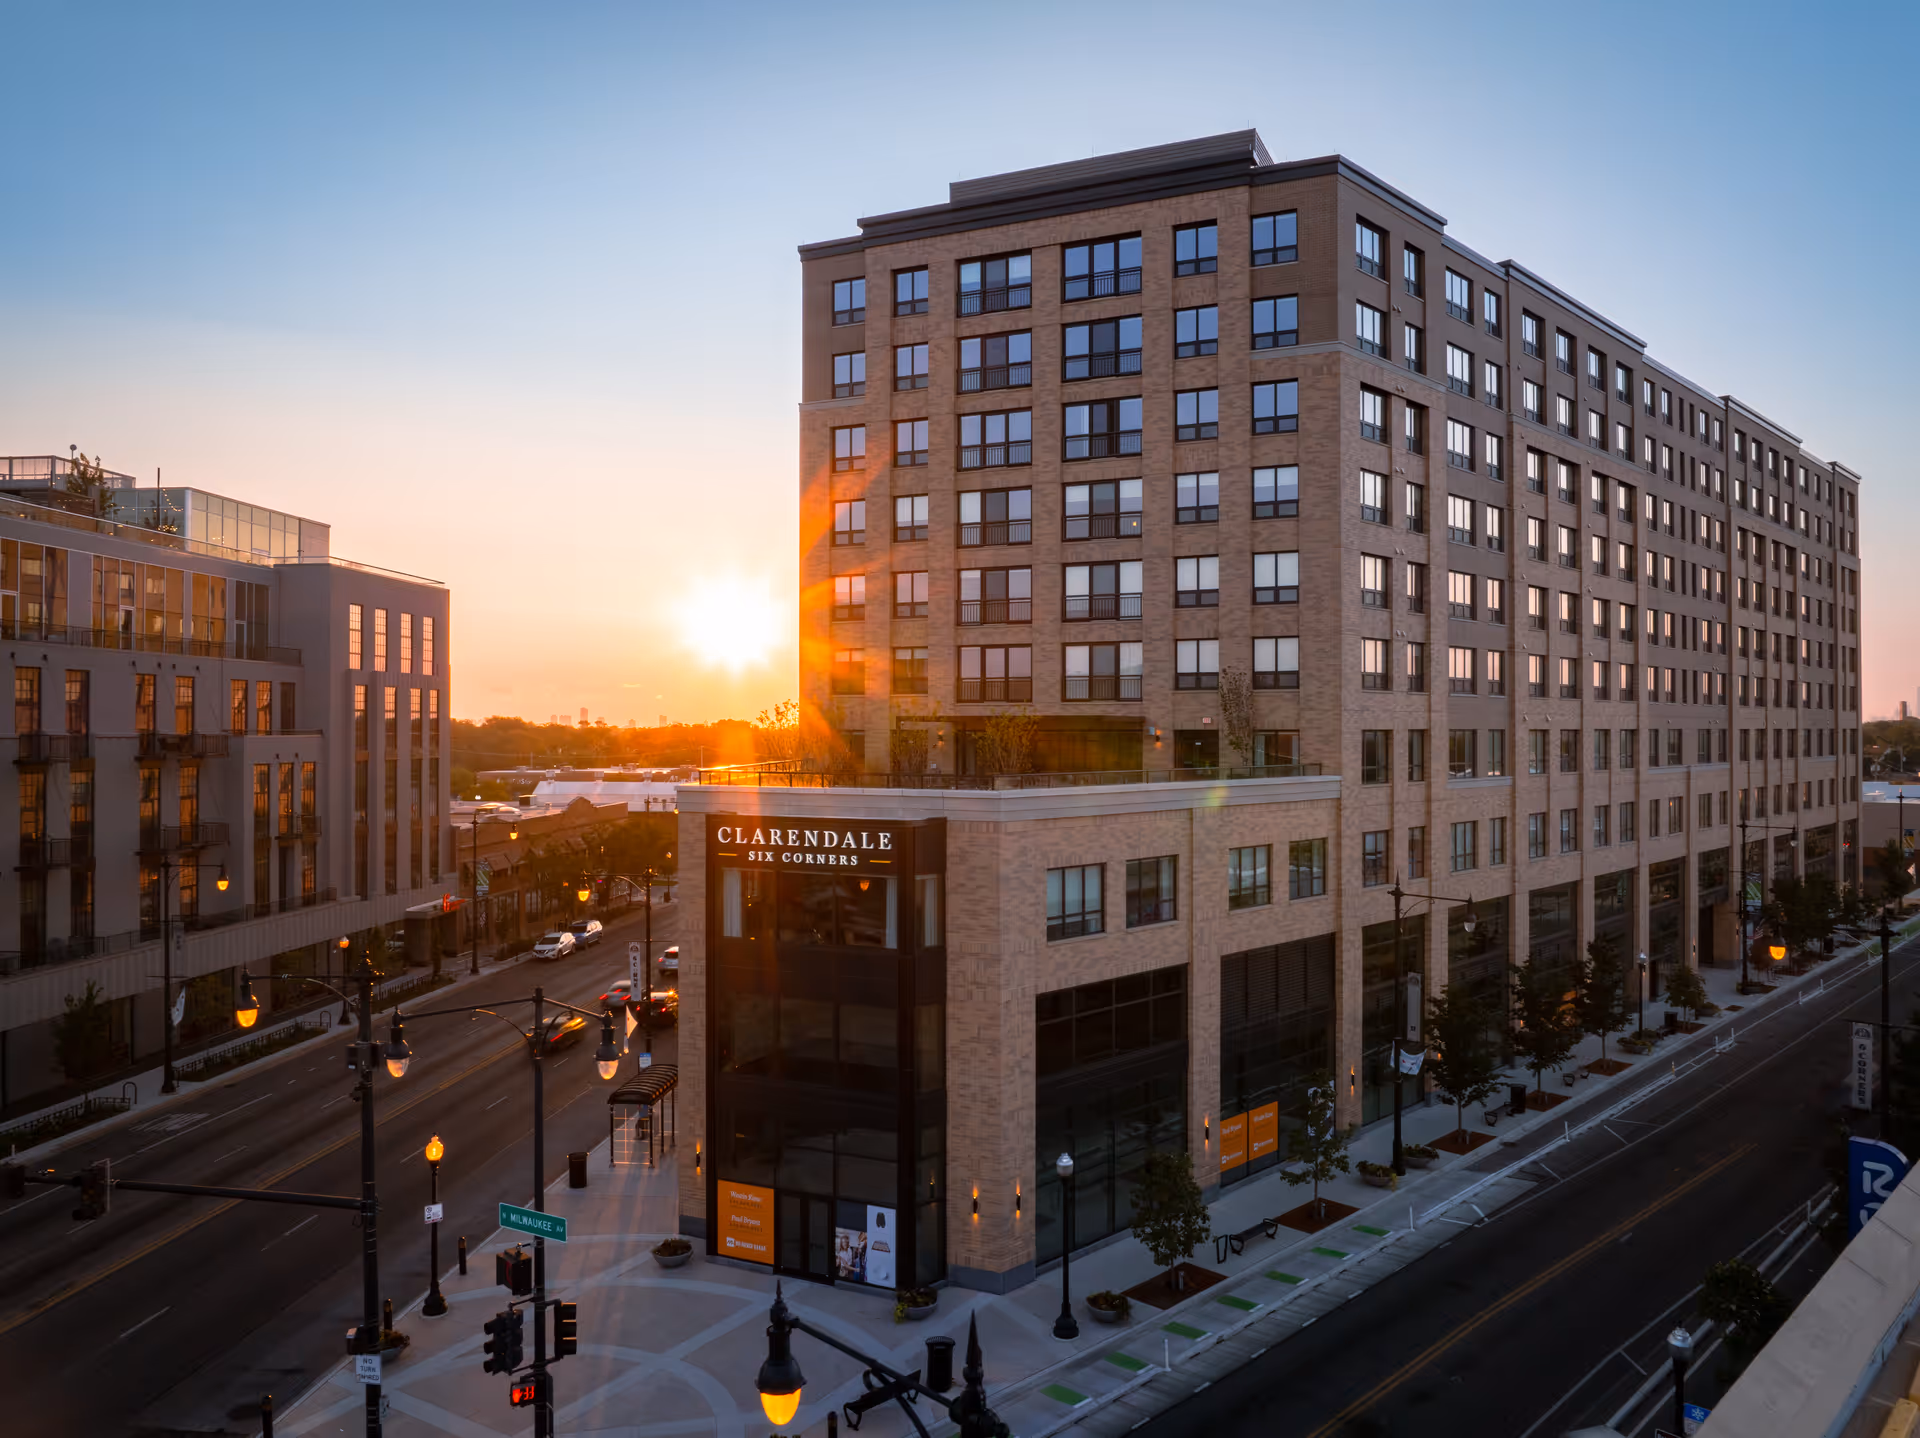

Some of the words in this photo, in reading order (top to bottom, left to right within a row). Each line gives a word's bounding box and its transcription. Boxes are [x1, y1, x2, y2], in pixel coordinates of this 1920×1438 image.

[717, 826, 893, 850] CLARENDALE
[748, 850, 775, 862] SIX
[782, 852, 859, 866] CORNERS
[510, 1213, 553, 1232] MILWAUKEE
[556, 1225, 564, 1233] AV
[360, 1365, 376, 1373] TURN
